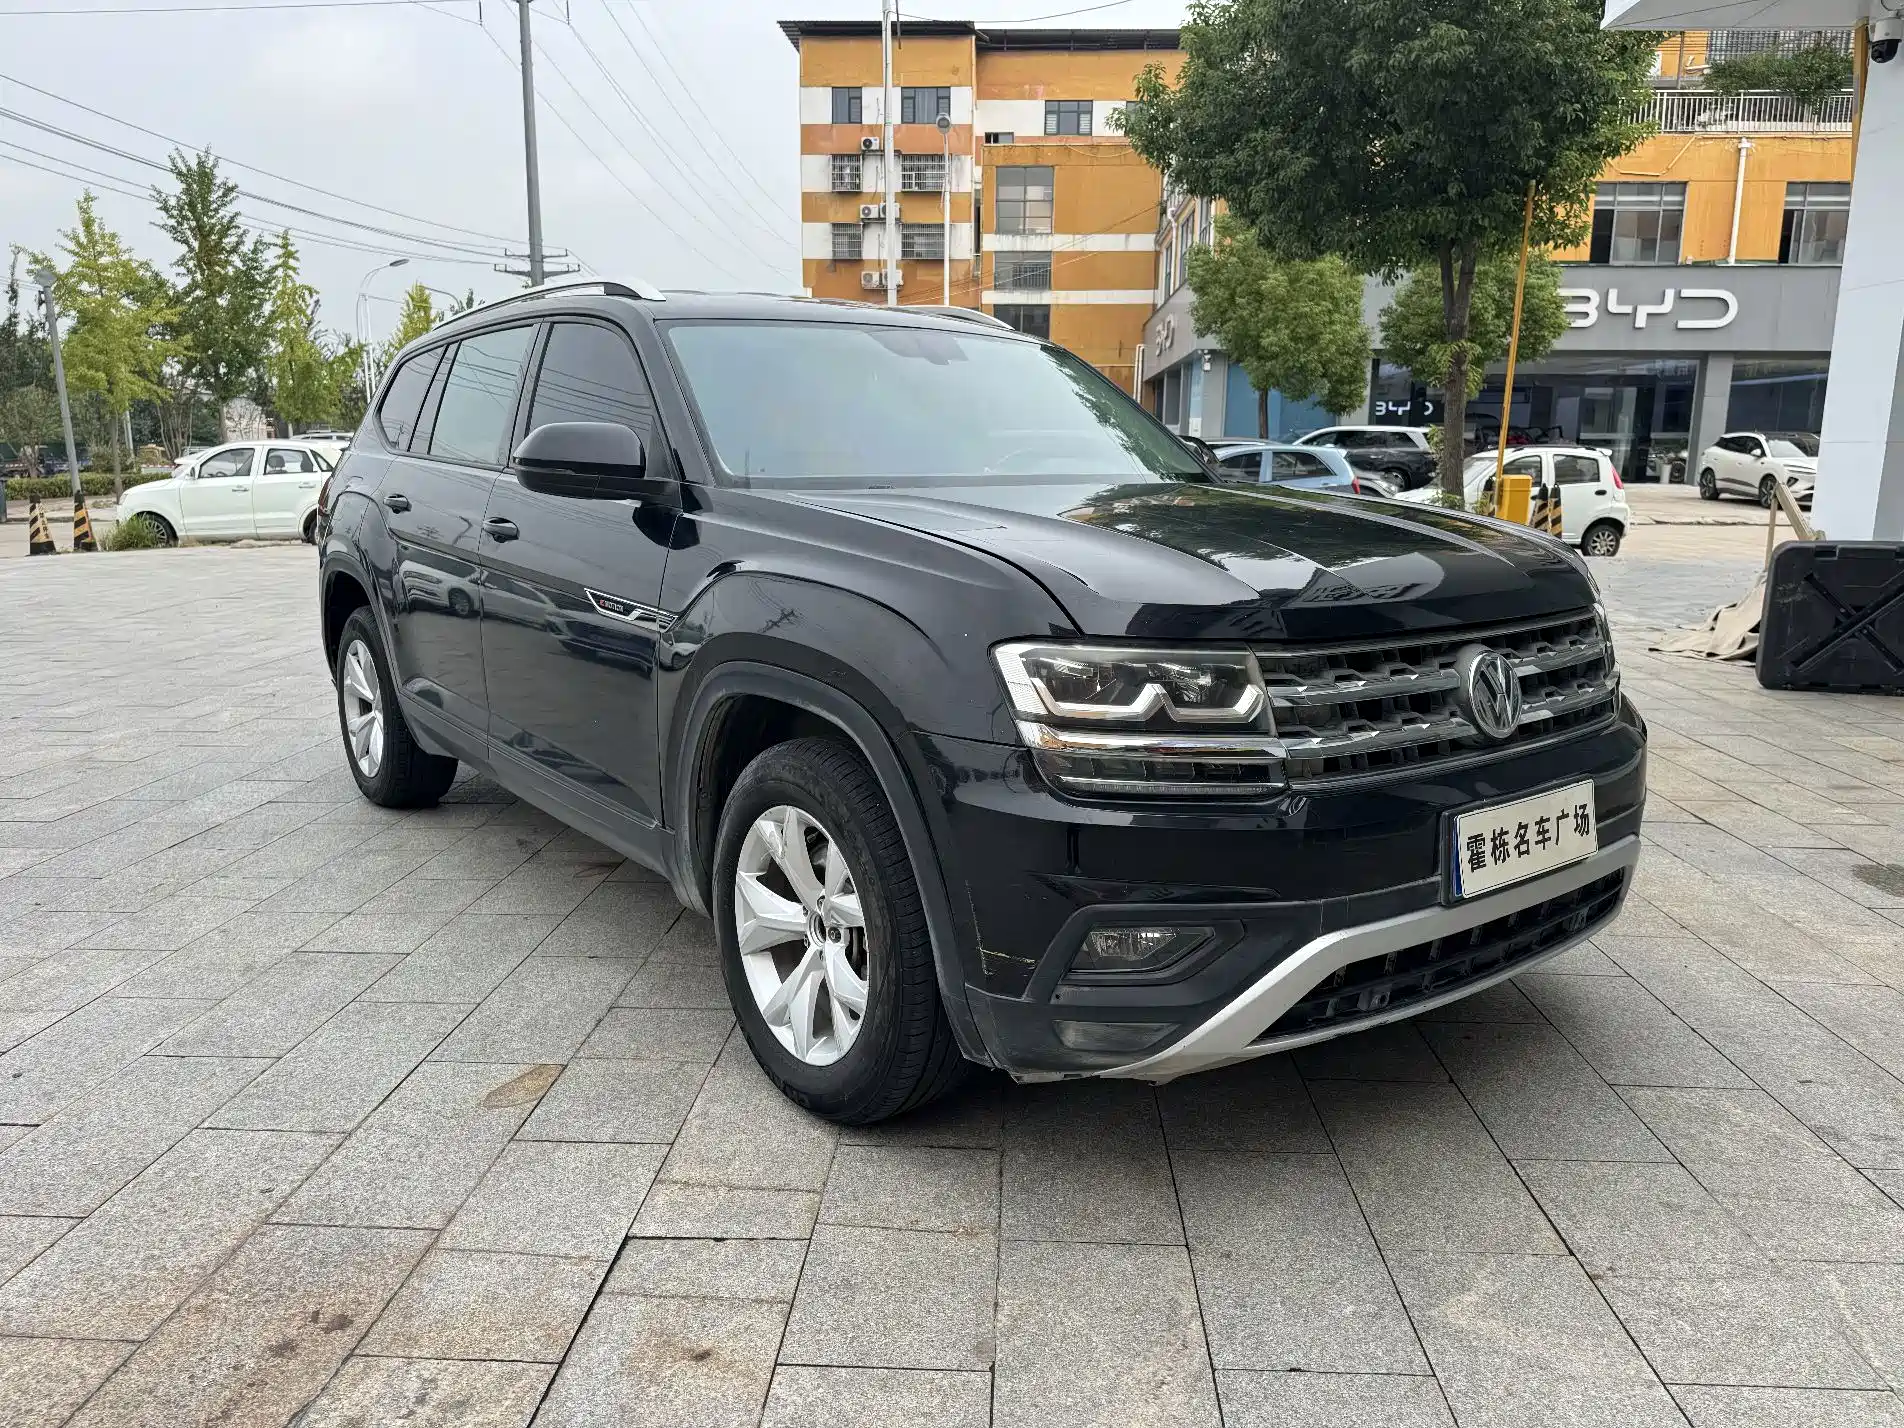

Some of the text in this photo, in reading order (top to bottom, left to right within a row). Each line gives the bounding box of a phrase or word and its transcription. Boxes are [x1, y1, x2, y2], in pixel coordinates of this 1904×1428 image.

[1558, 288, 1739, 329] BYD
[1466, 803, 1590, 873] 霍栋名车广场
